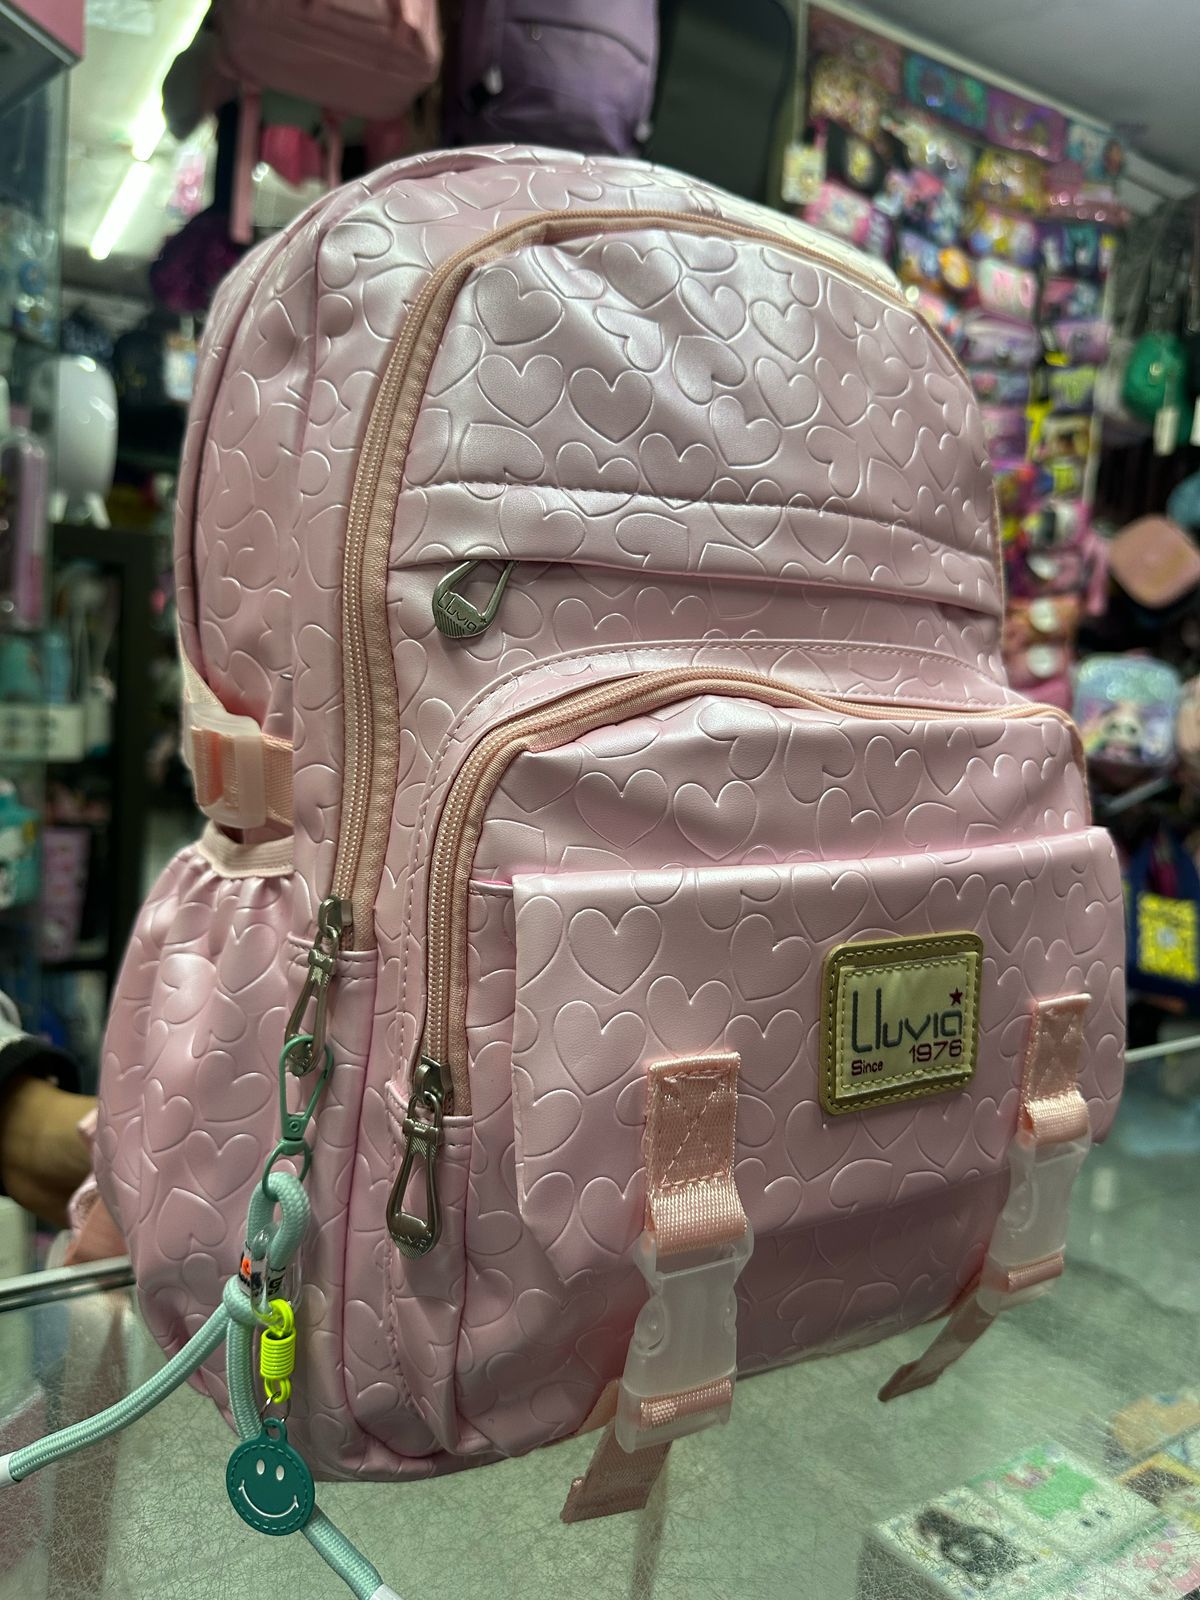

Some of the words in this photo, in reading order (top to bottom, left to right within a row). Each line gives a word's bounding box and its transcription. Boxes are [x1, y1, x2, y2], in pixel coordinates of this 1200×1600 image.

[851, 987, 963, 1054] Lluvia
[851, 1059, 884, 1077] Since
[908, 1039, 963, 1064] 1976
